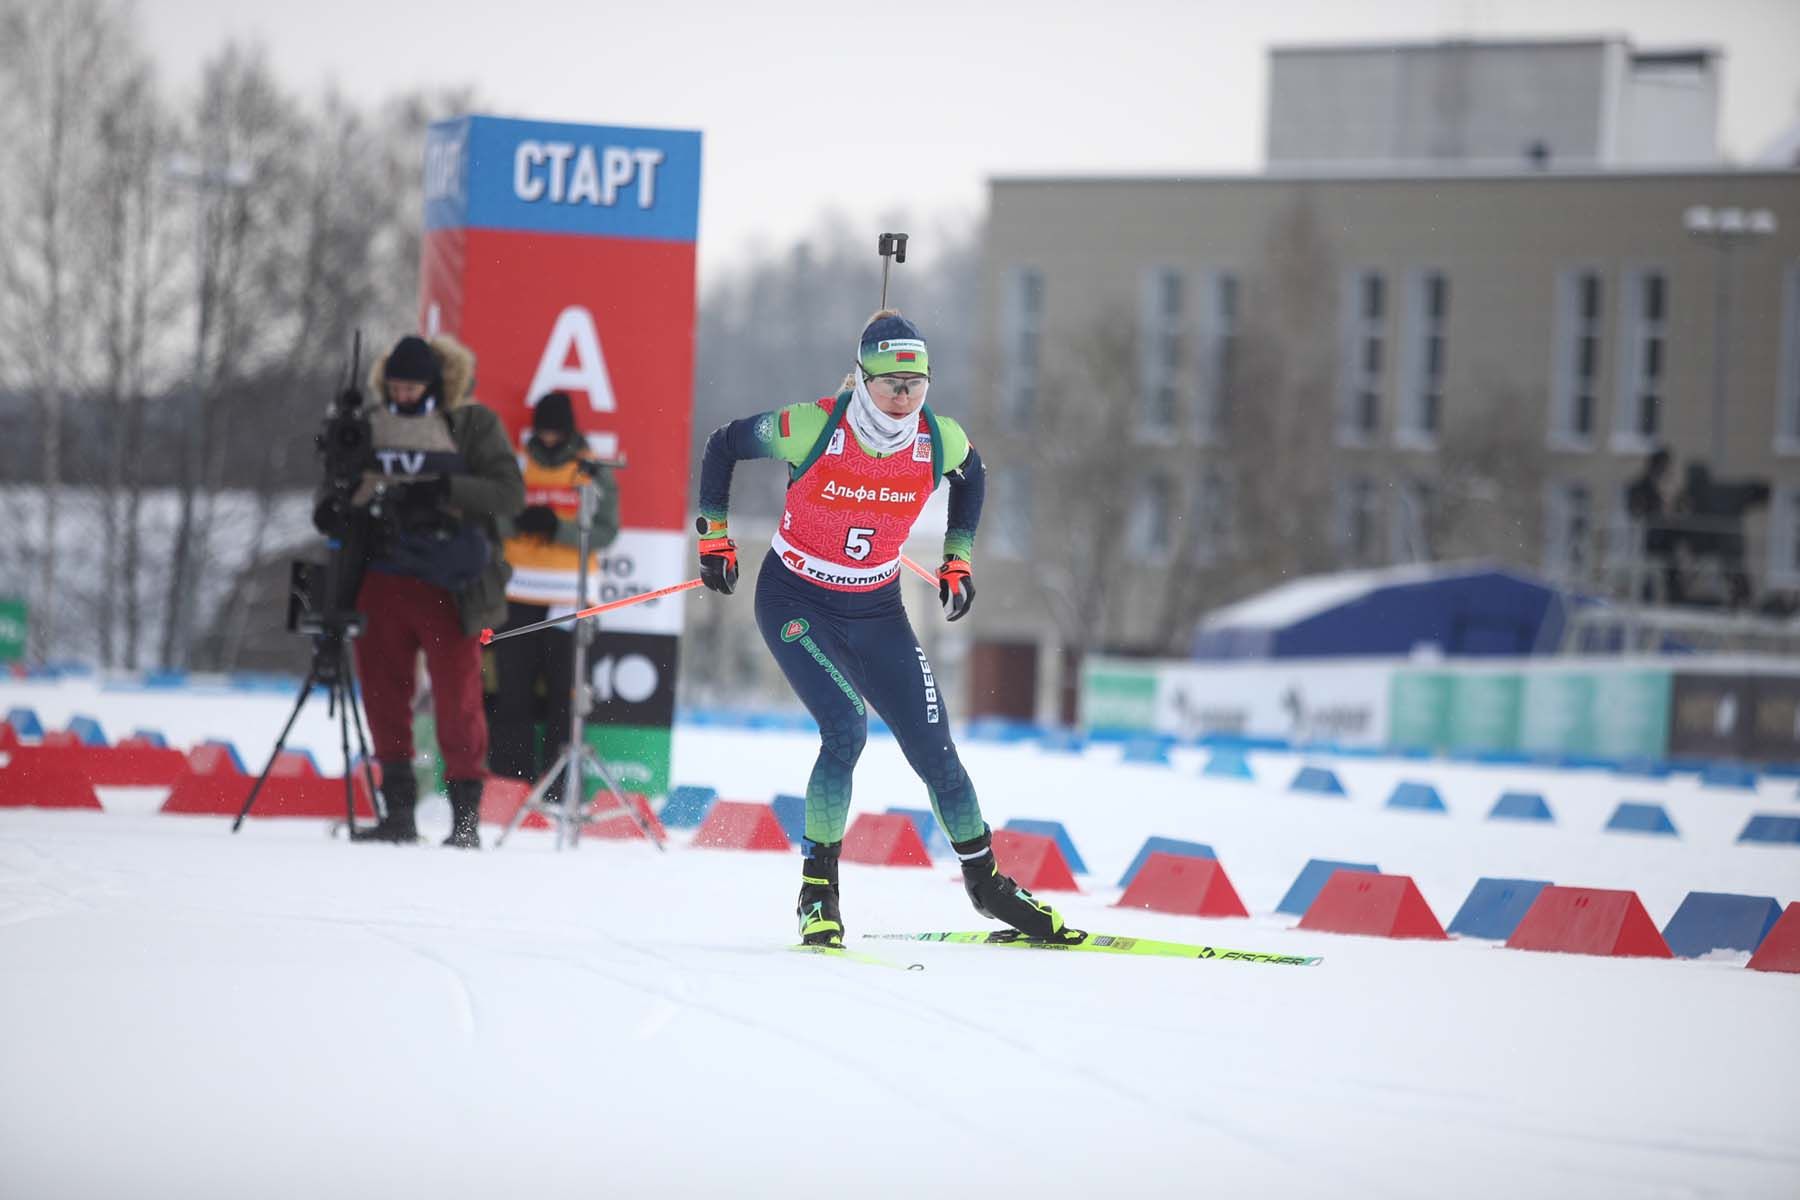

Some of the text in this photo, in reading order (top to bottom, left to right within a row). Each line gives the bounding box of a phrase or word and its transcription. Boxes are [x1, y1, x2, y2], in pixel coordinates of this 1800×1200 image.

[513, 141, 664, 209] СТАРТ
[375, 452, 426, 476] TV
[823, 480, 917, 503] Альфа Банк
[844, 526, 876, 561] 5
[1220, 951, 1306, 967] FISCHER
